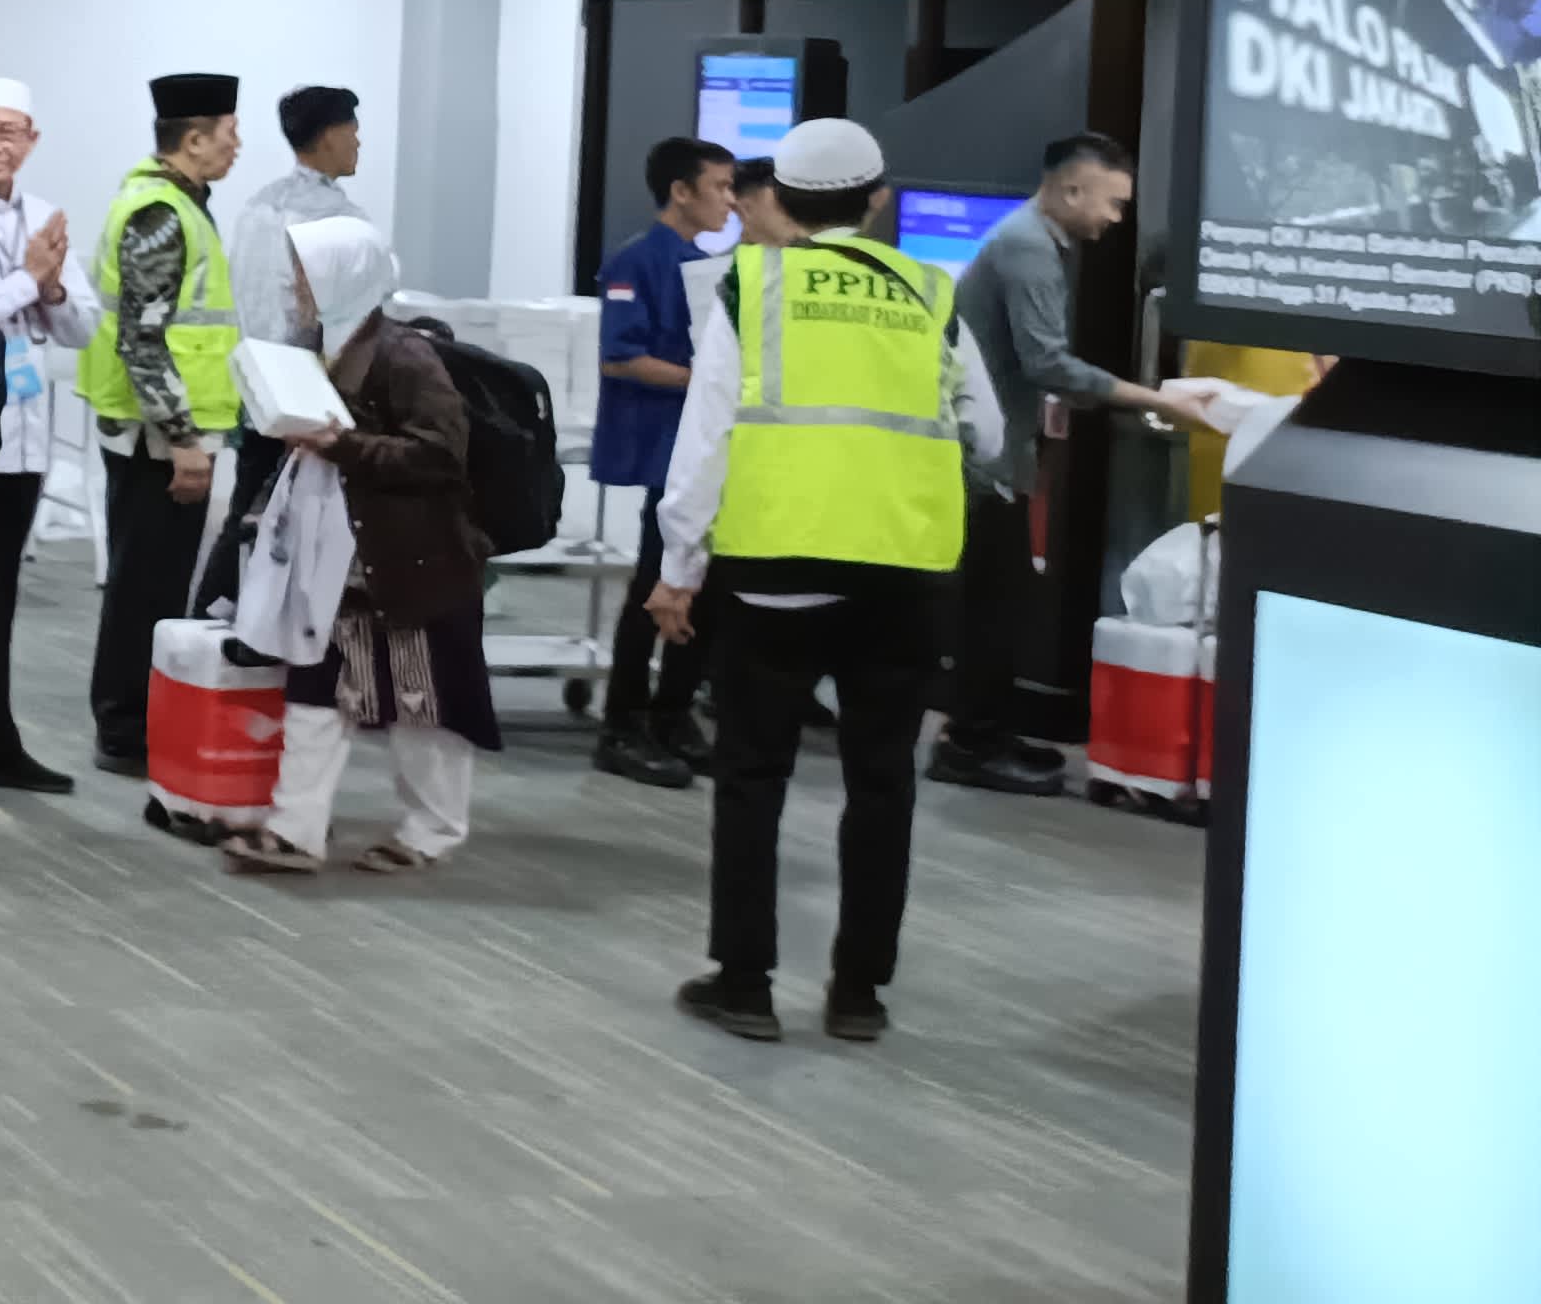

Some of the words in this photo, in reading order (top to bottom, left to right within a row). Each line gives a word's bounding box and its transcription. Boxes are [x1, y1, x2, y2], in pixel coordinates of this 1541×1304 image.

[1228, 11, 1333, 113] DKI
[1271, 224, 1303, 247] DKI
[1306, 228, 1366, 251] Jakarta
[1252, 251, 1296, 276] Pajak
[1475, 269, 1532, 297] (PKB)
[1315, 284, 1337, 304] 31
[1338, 286, 1408, 311] Agustus
[1409, 293, 1455, 316] 2024
